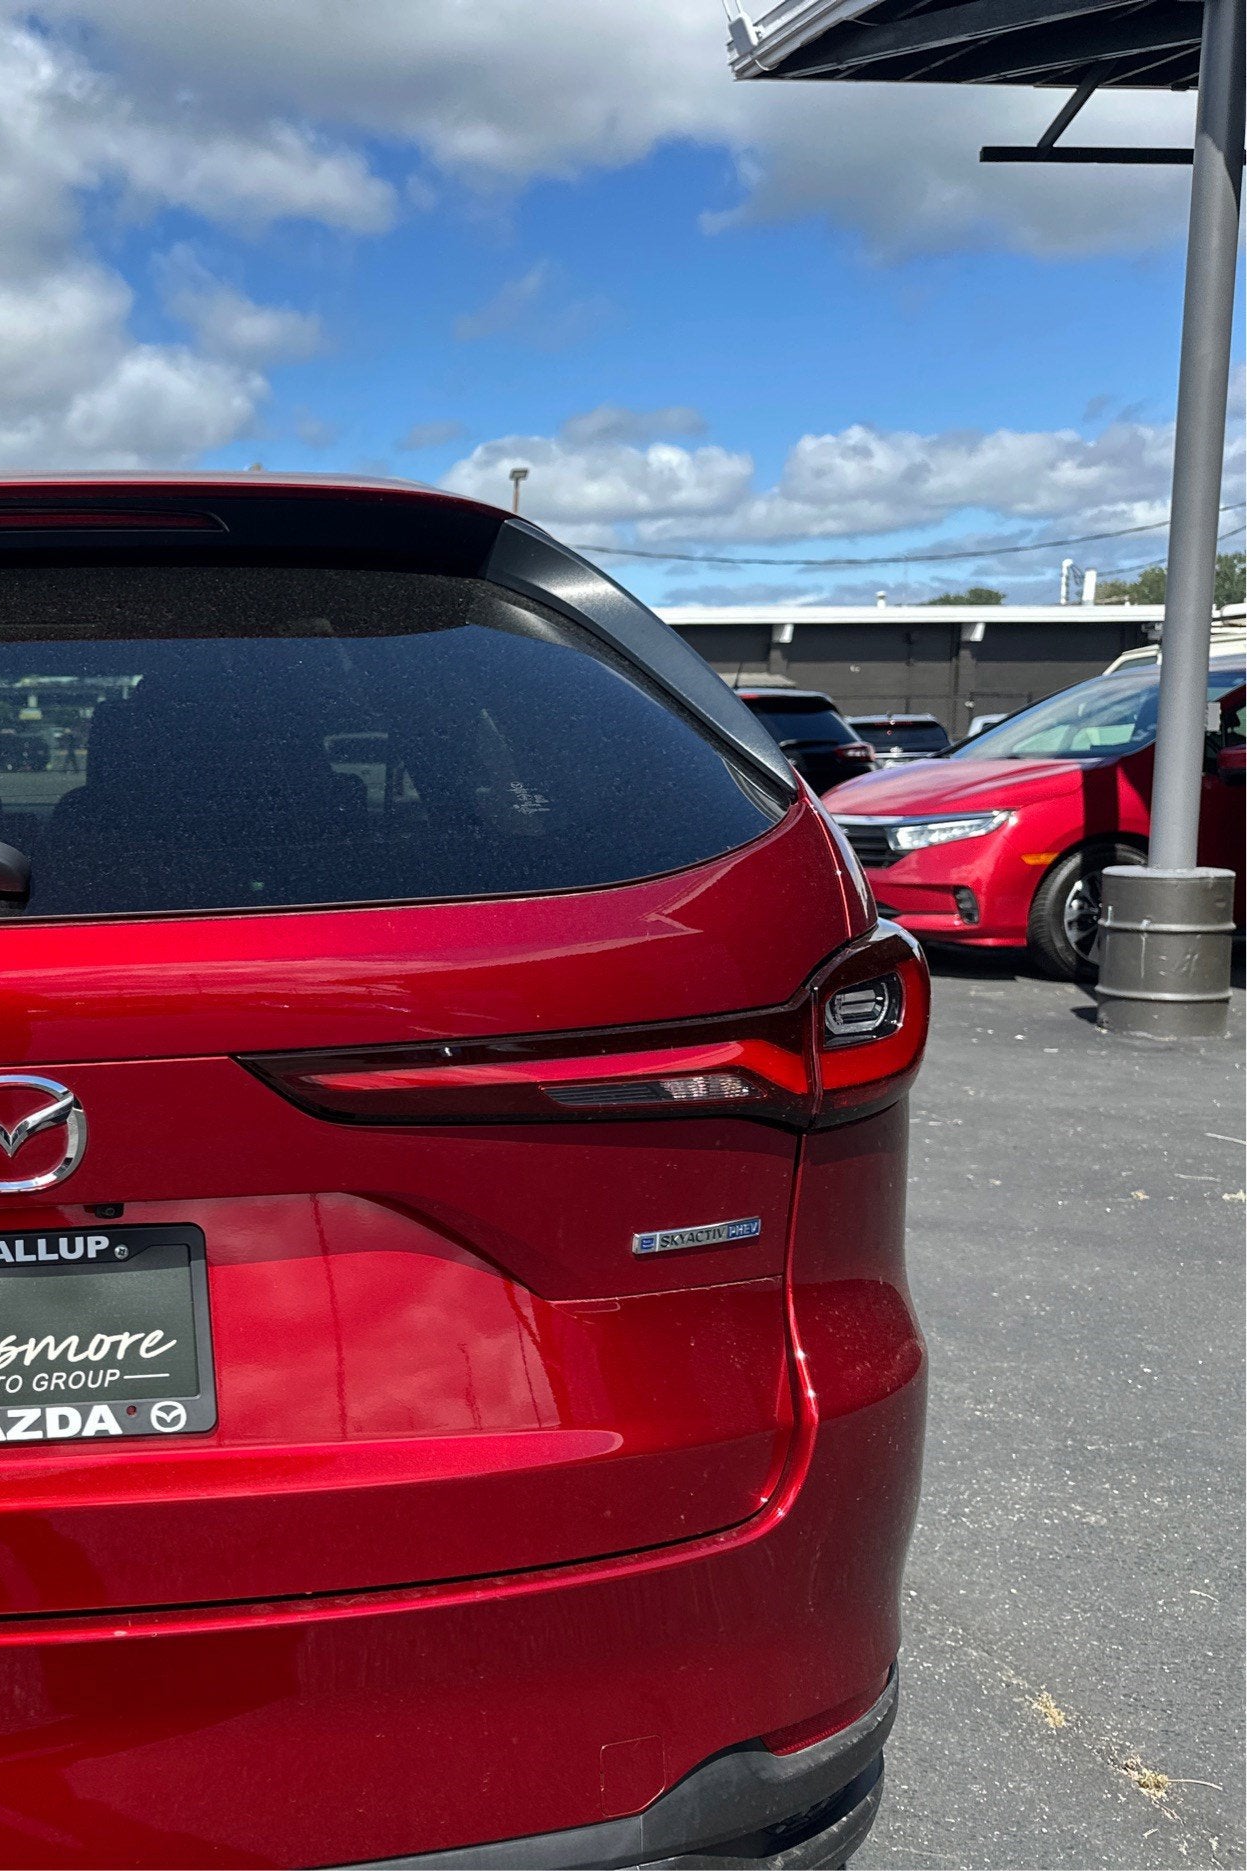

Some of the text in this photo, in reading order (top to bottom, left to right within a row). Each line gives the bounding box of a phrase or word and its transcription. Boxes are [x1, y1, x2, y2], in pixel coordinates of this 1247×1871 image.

[660, 1227, 726, 1248] SKYACTIV
[729, 1222, 758, 1238] PHEV
[31, 1369, 121, 1392] GROUP
